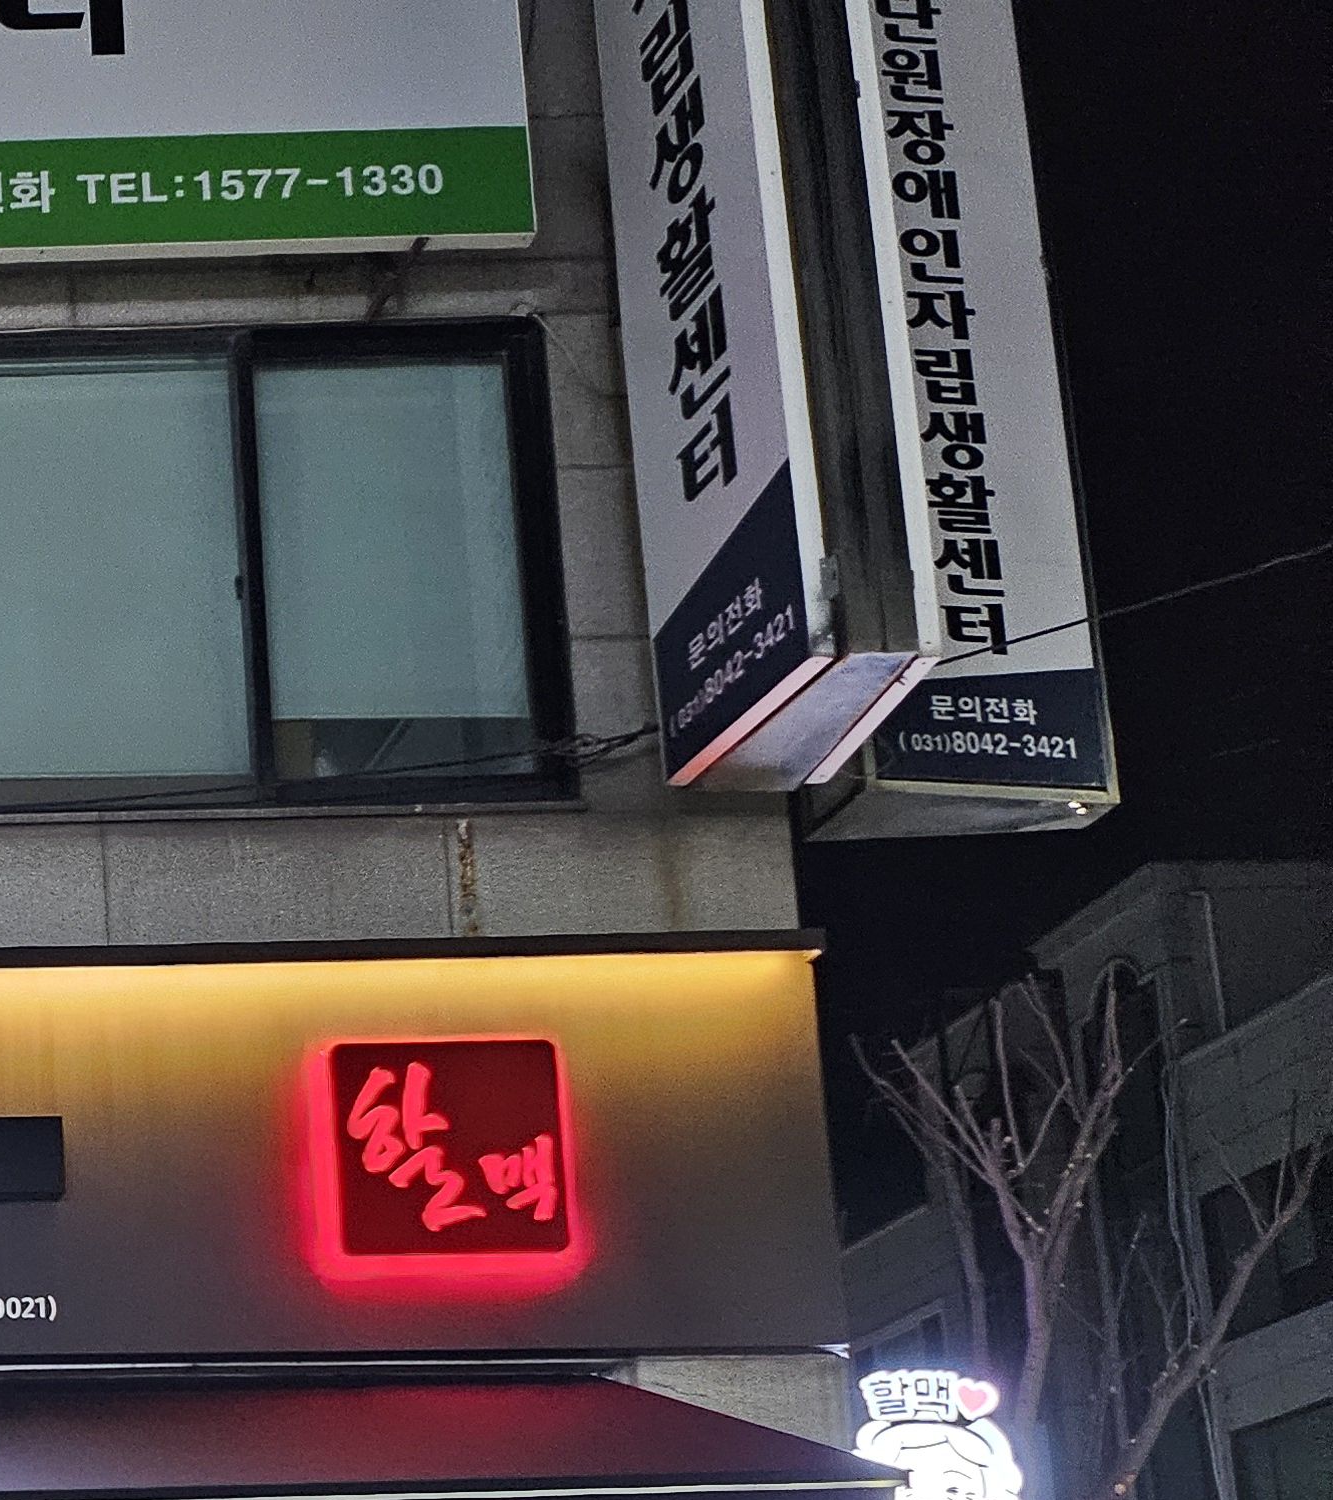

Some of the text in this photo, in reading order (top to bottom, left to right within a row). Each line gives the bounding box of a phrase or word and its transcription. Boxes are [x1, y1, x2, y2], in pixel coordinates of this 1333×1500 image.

[639, 0, 735, 502] 립생활센터
[687, 577, 763, 672] 문의전화
[929, 694, 1037, 726] 문의전화
[346, 1061, 559, 1233] 할맥
